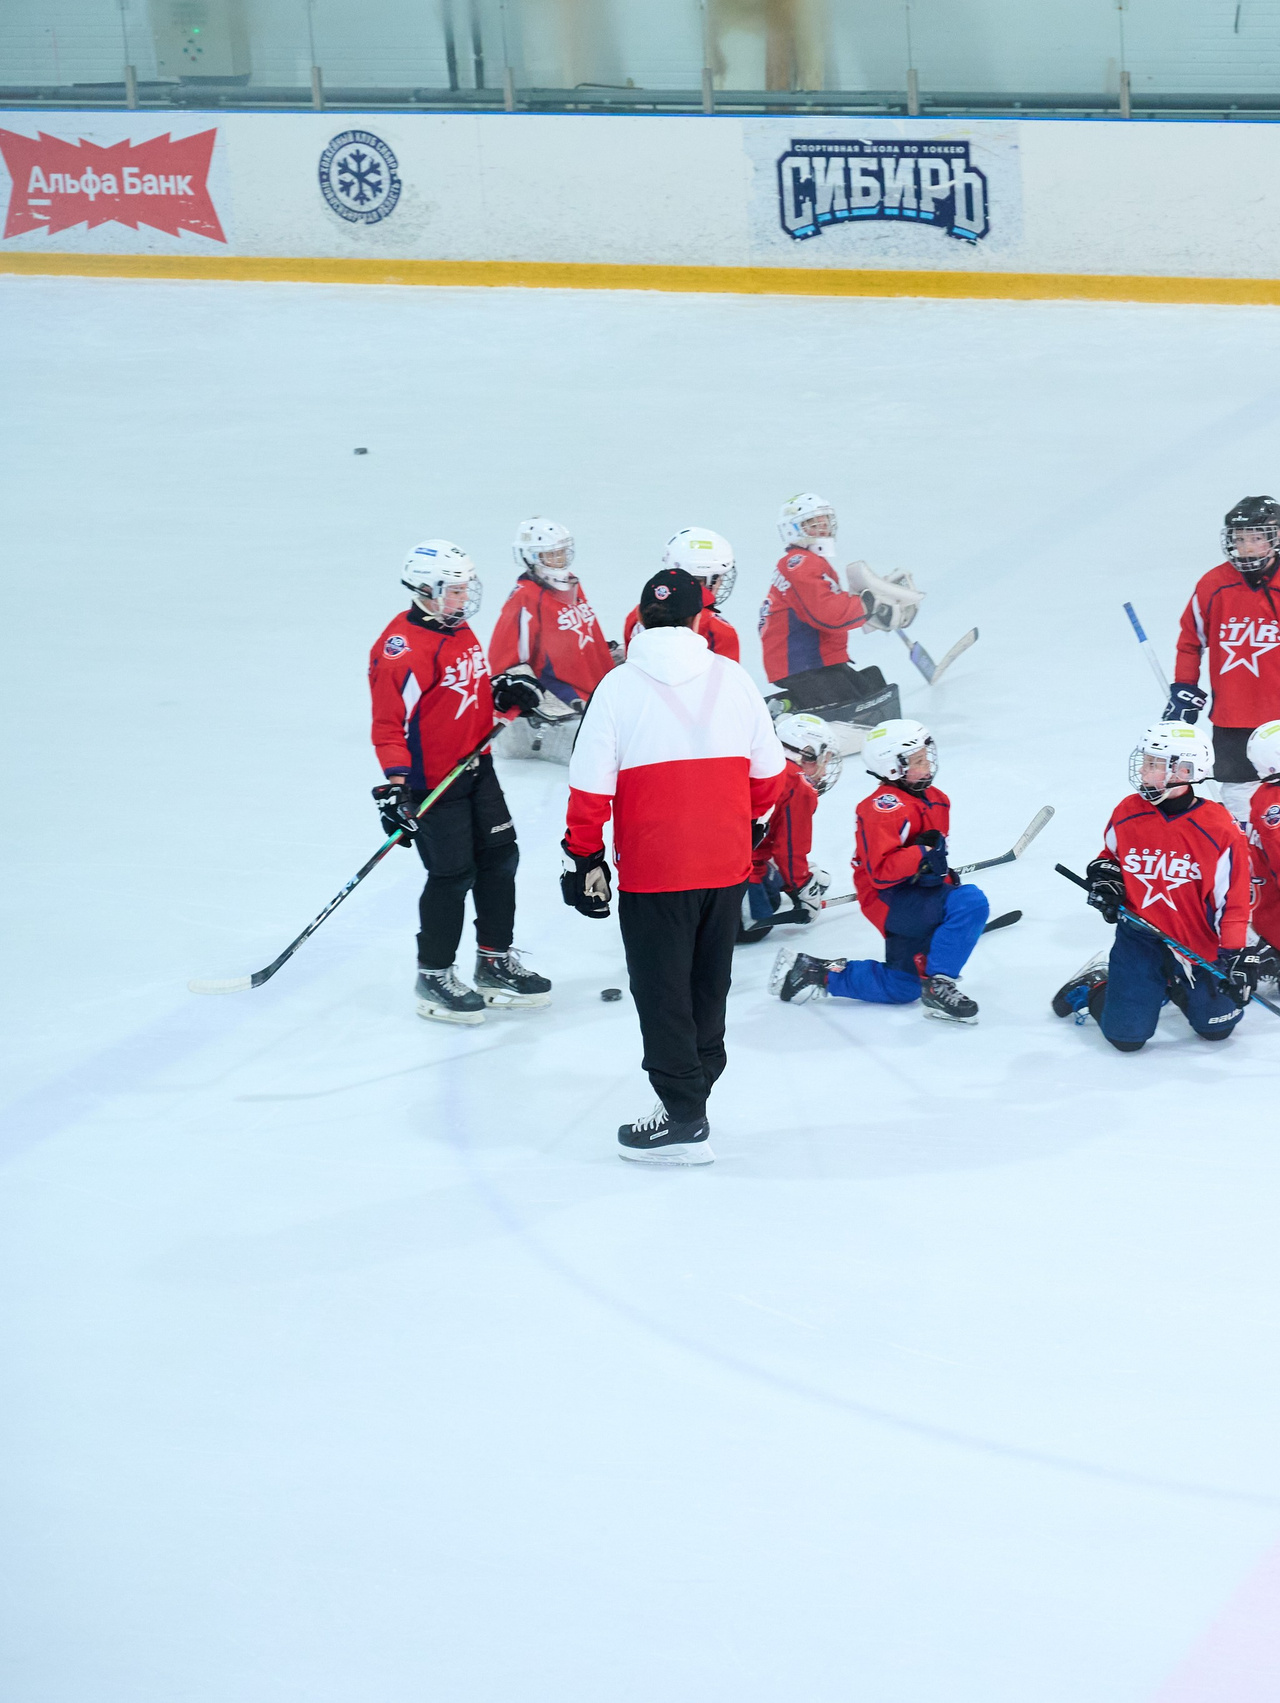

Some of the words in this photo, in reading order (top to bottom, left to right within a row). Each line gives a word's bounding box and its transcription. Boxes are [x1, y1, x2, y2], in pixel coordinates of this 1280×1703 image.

[794, 144, 860, 153] СПОРТИВНАЯ
[863, 145, 900, 154] ШКОЛА
[904, 145, 919, 154] ПО
[923, 145, 966, 154] ХОККЕЮ
[27, 165, 119, 201] Альфа
[122, 166, 195, 196] Банк
[780, 155, 984, 233] СИБИРЬ
[1177, 689, 1207, 708] CC
[1129, 848, 1191, 860] BOSTO
[1122, 853, 1202, 880] STARS
